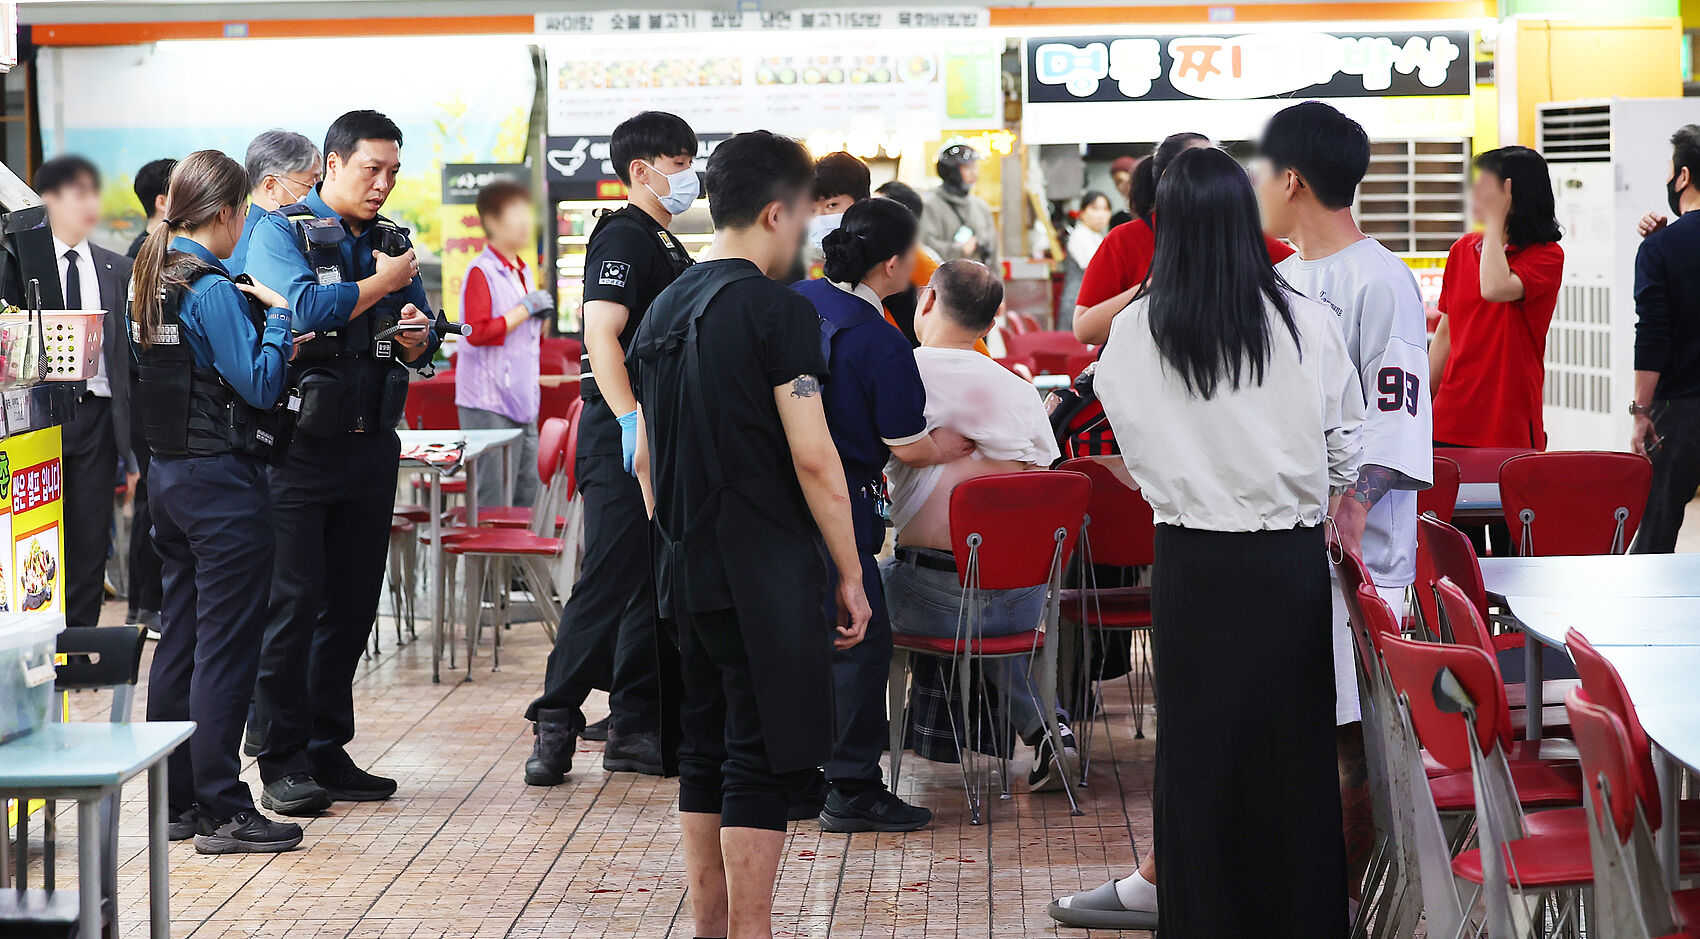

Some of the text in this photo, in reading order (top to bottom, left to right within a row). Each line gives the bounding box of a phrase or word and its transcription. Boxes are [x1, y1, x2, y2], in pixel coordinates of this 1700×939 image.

[649, 13, 696, 30] 불고기
[27, 470, 41, 507] 셀프
[41, 461, 60, 502] 입니다
